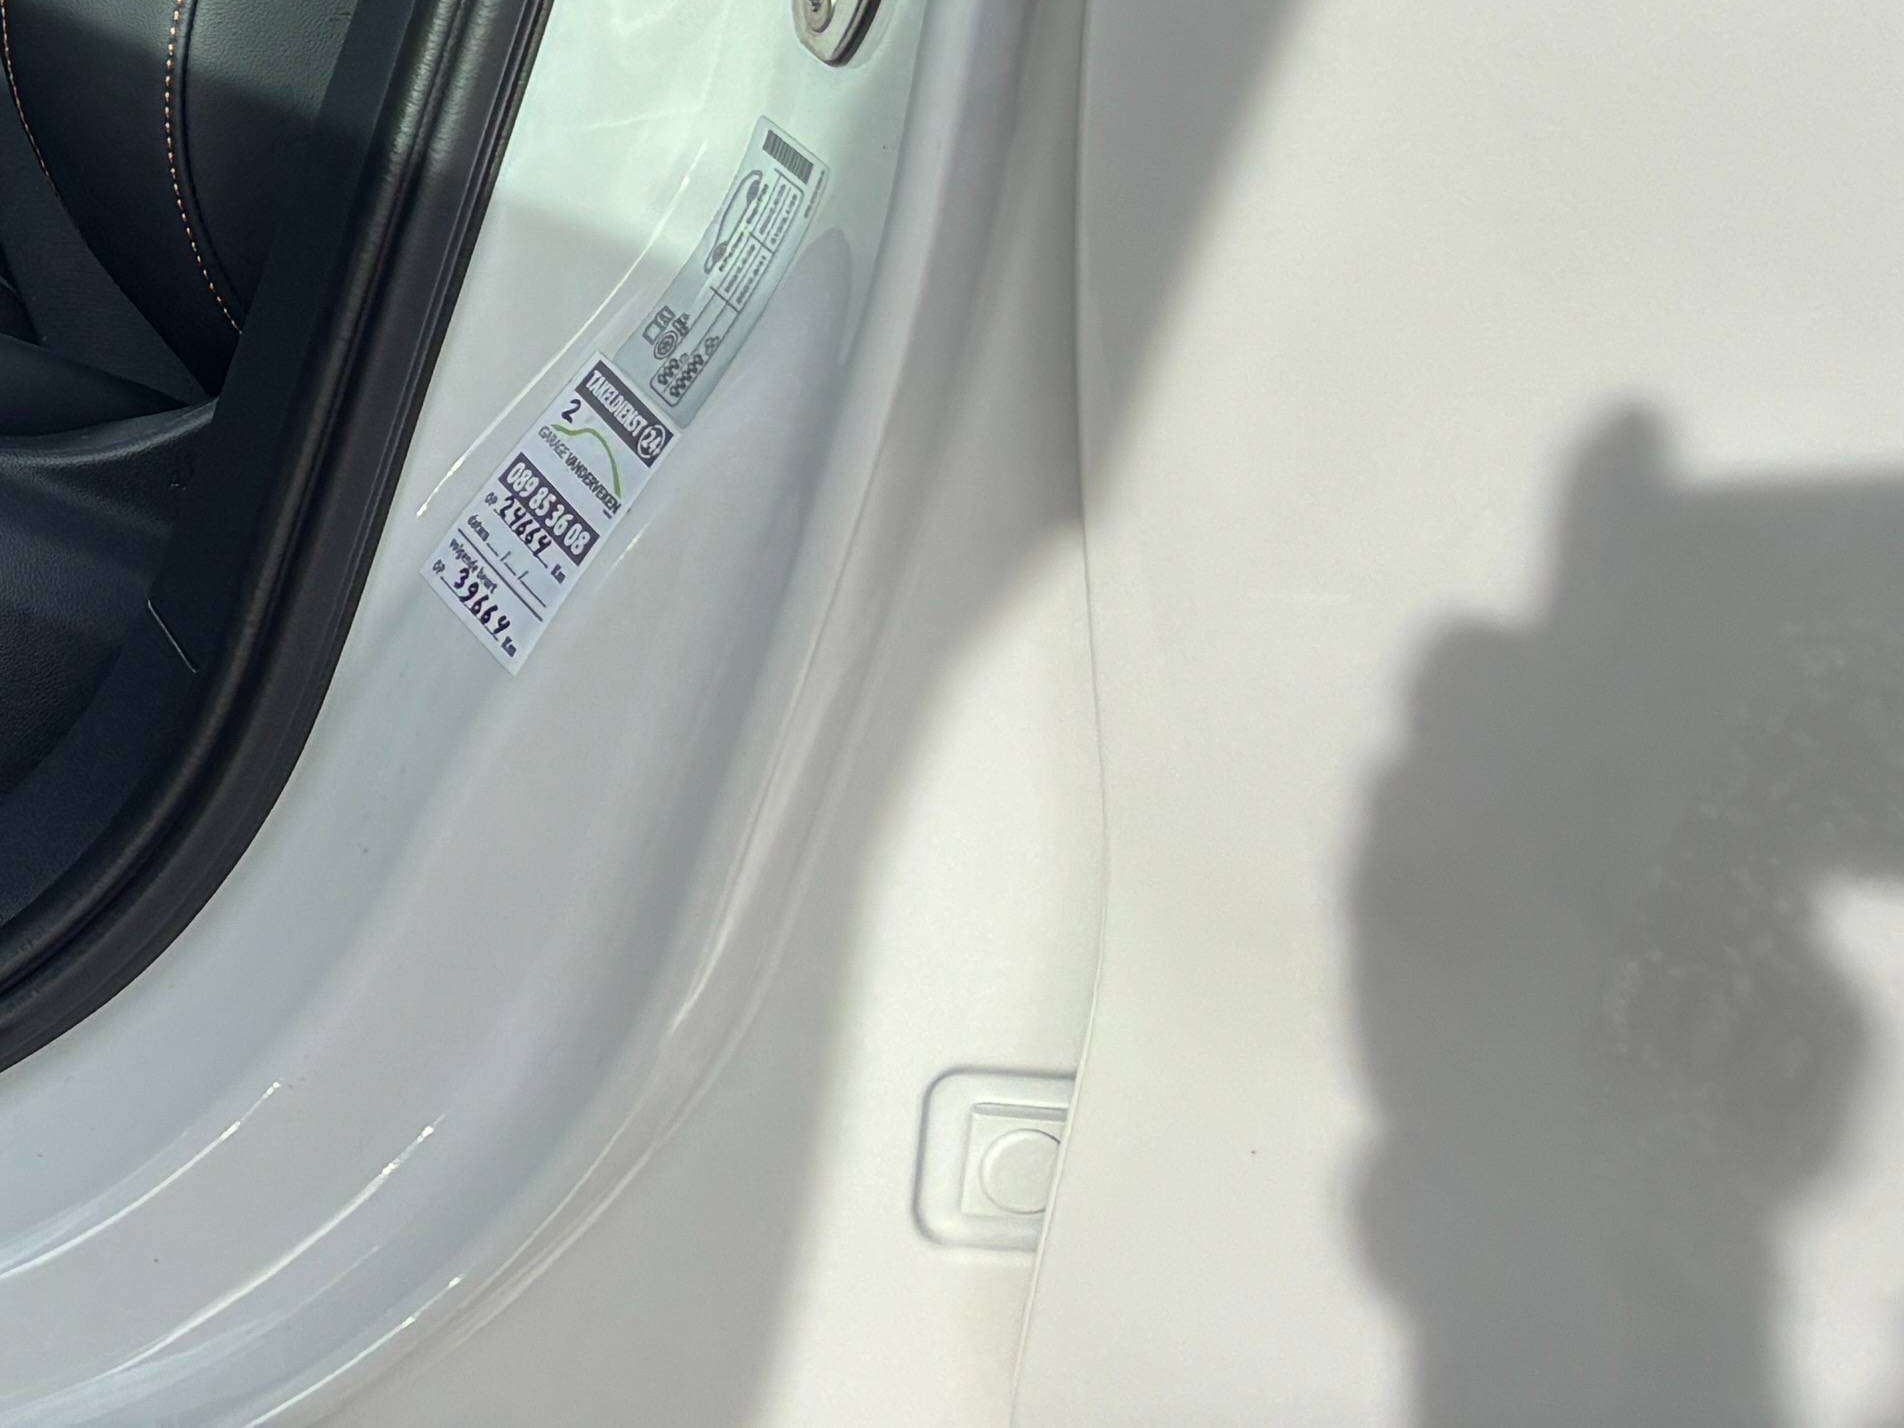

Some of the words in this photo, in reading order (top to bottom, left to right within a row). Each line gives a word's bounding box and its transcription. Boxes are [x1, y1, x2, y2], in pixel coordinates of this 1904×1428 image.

[561, 399, 581, 423] 2
[586, 369, 648, 437] TAKELDIENST
[538, 425, 570, 460] GARAGE
[499, 495, 552, 557] 24664
[506, 462, 540, 497] 089
[528, 486, 557, 517] 85
[544, 504, 574, 536] 36
[563, 523, 591, 555] 08
[453, 567, 511, 635] 39664
